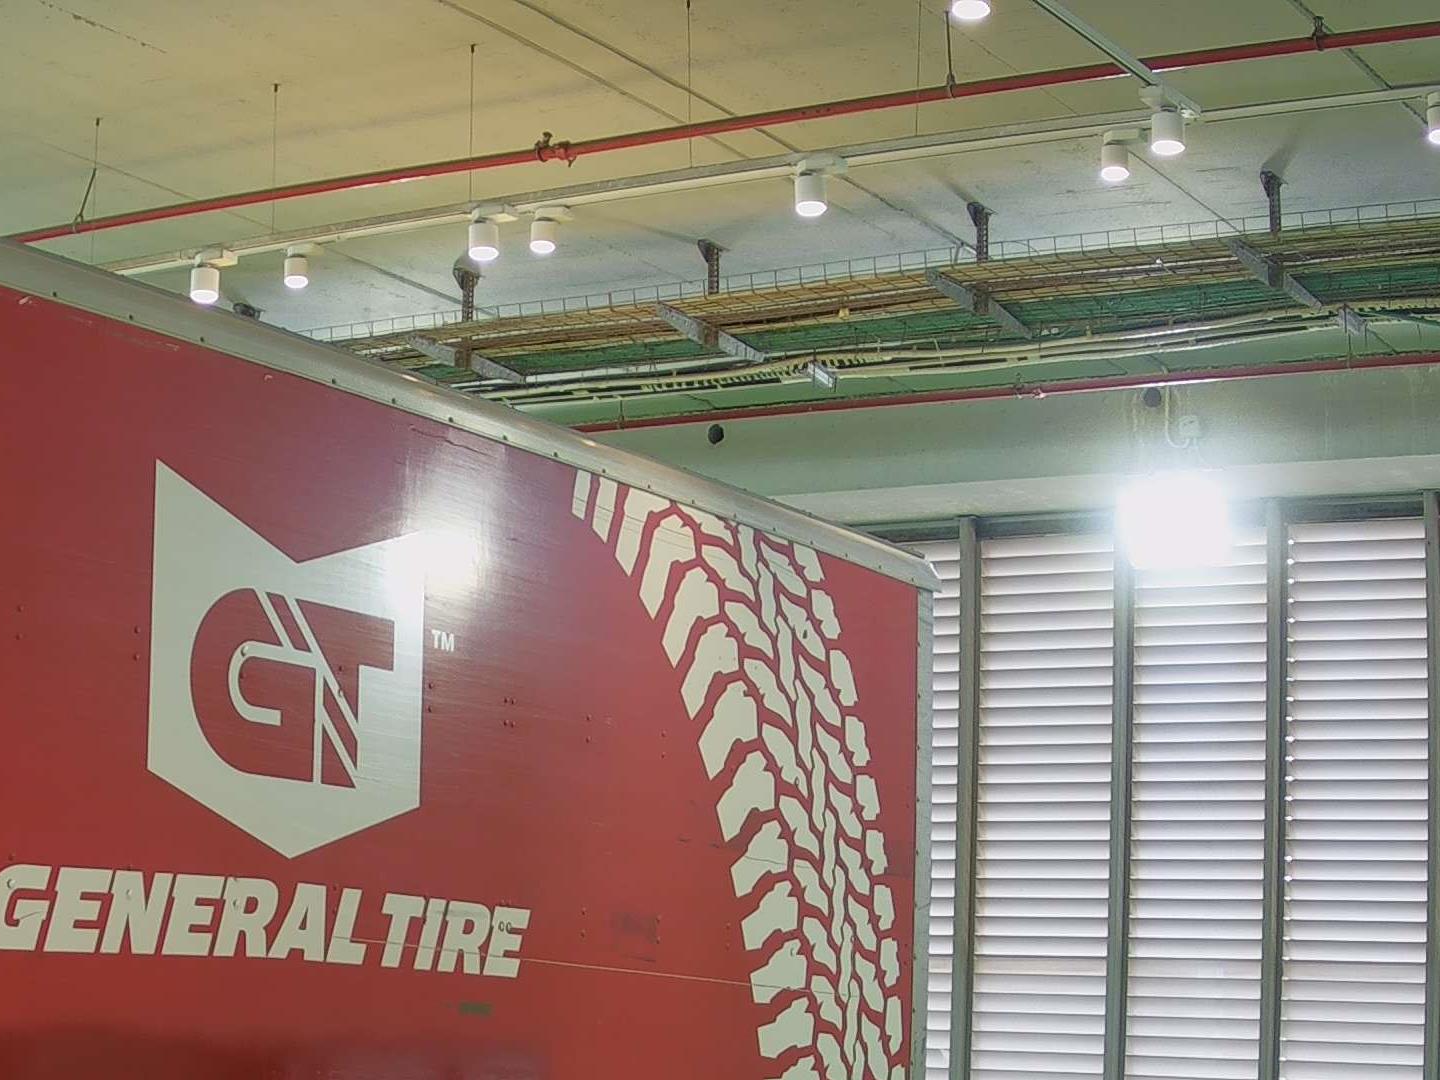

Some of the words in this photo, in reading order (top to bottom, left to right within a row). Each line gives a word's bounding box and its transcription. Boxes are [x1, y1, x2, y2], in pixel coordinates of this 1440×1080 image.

[431, 629, 455, 652] TM
[190, 587, 395, 790] GT
[380, 892, 531, 979] TIRE
